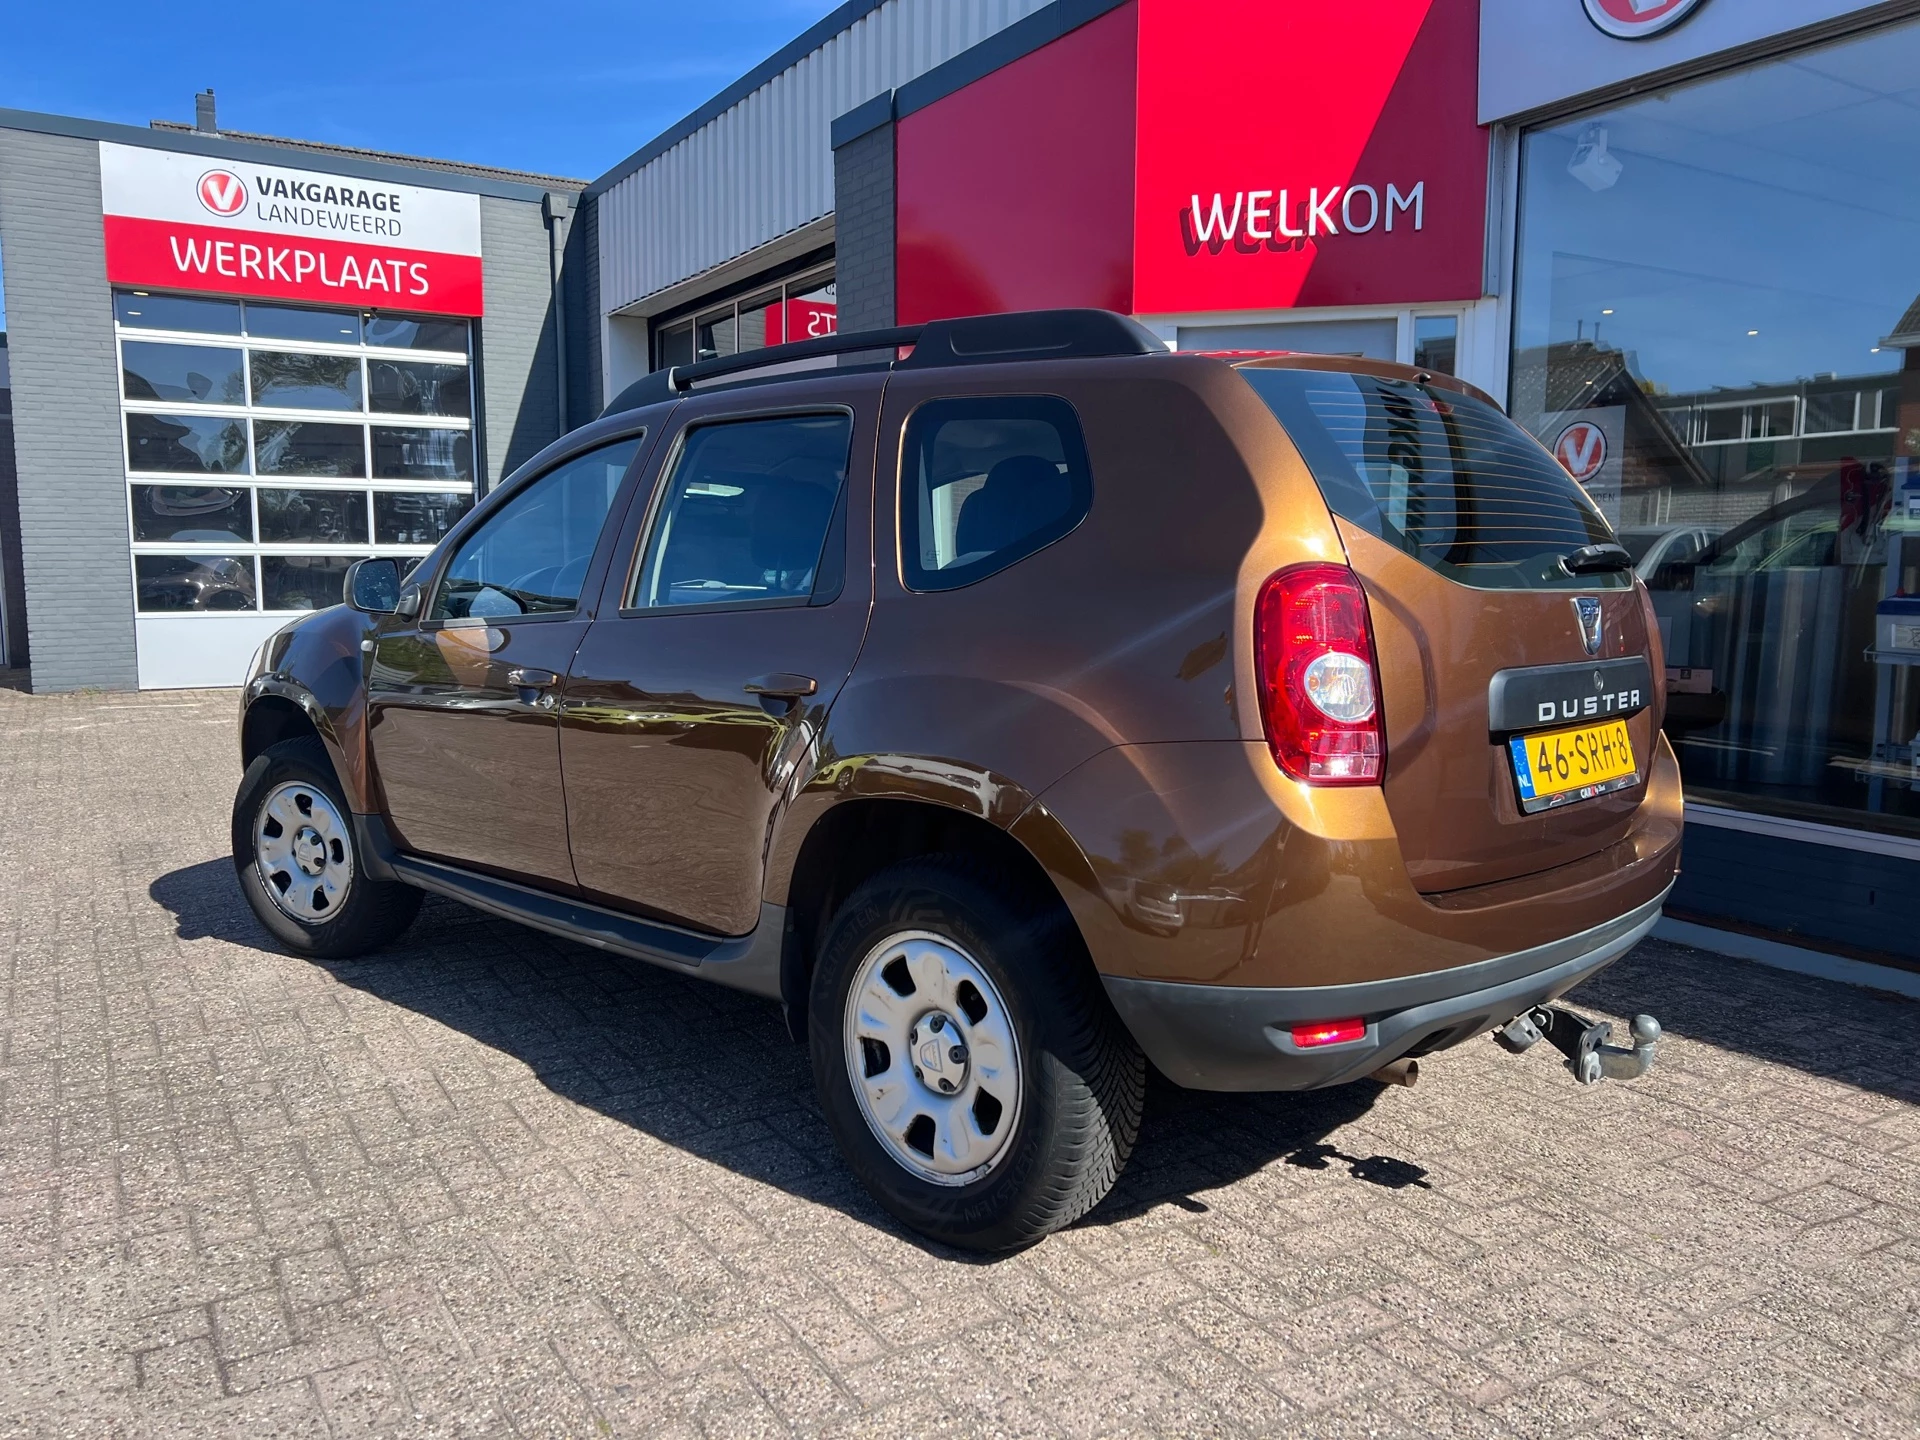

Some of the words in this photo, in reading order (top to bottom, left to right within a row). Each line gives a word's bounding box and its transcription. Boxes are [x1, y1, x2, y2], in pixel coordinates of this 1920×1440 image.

[256, 176, 401, 213] VAKGARAGE
[1191, 181, 1424, 242] WELKOM
[257, 202, 402, 237] LANDEWEERD
[169, 236, 429, 295] WERKPLAATS
[1538, 689, 1640, 722] DUSTER
[1537, 726, 1628, 783] 46-SRH-8
[1518, 774, 1532, 788] NL
